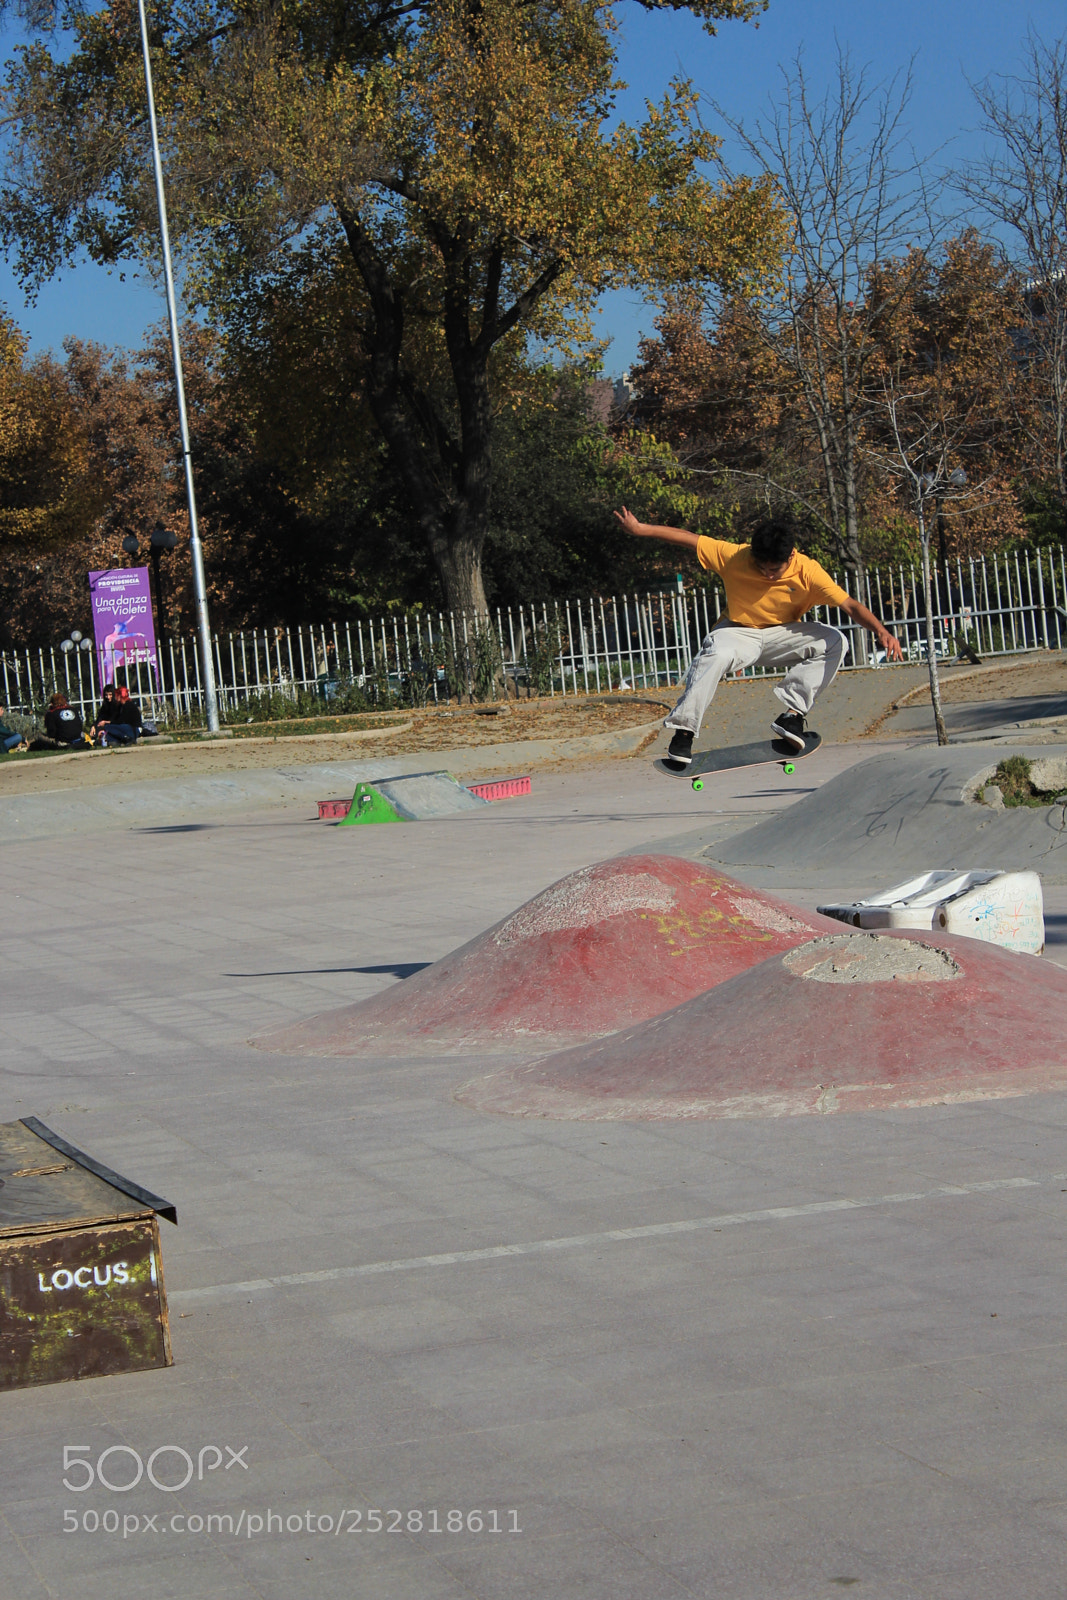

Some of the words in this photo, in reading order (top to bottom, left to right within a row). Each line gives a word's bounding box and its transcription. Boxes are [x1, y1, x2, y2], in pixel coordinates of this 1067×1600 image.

[98, 578, 140, 587] PROVIDENCIA
[95, 597, 115, 607] Una
[116, 594, 147, 605] danza
[97, 606, 111, 614] para
[112, 604, 147, 615] Violeta
